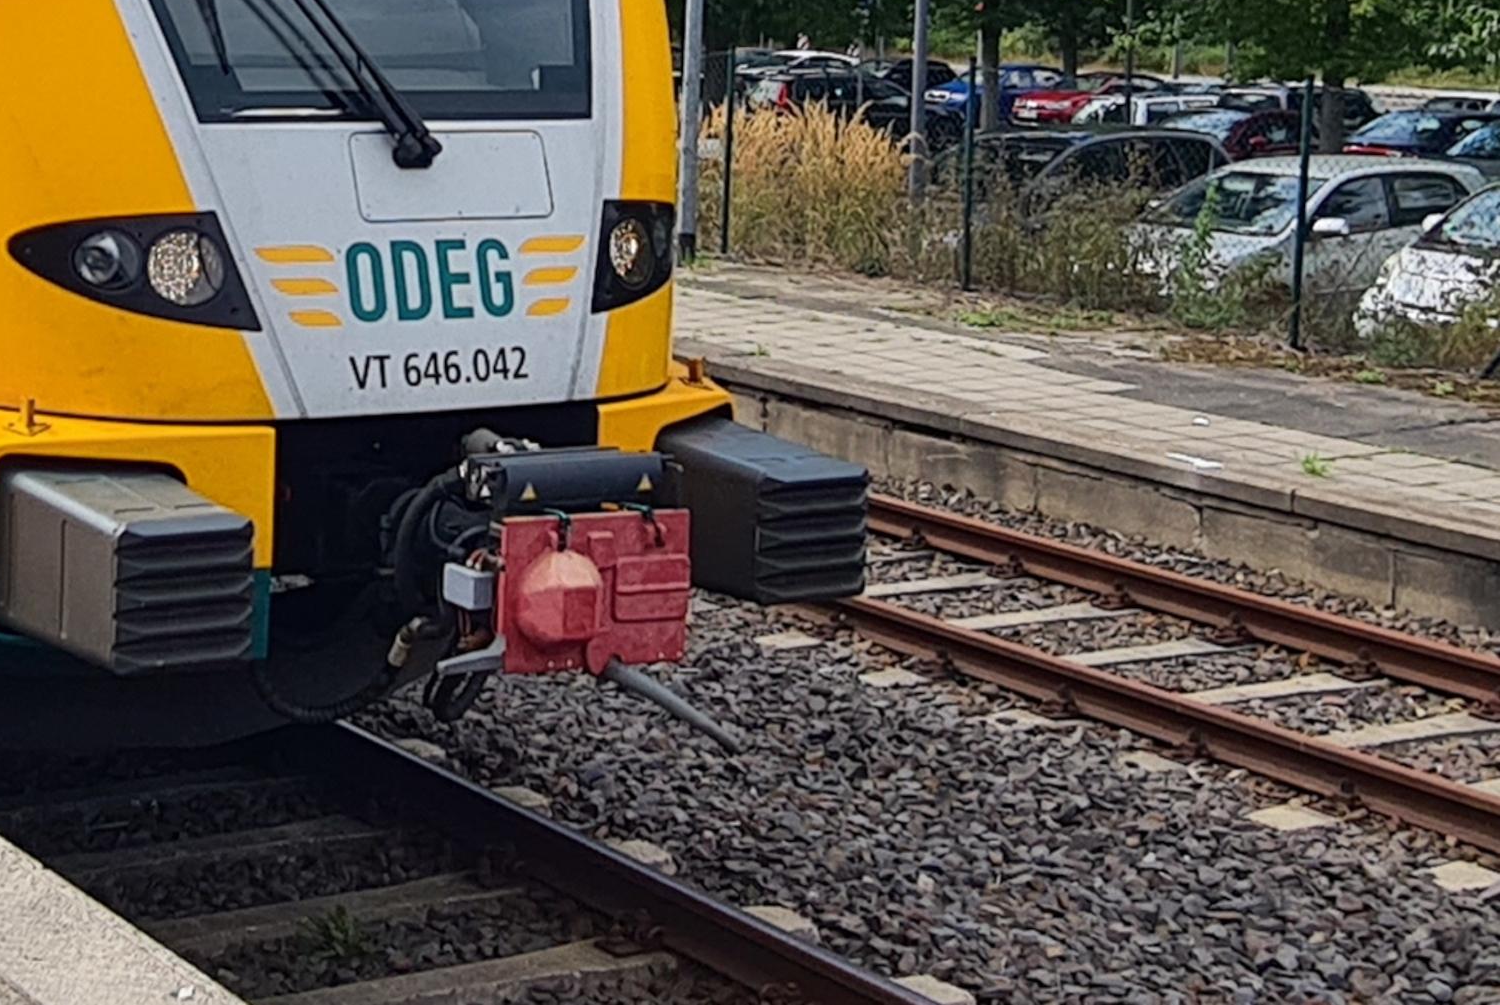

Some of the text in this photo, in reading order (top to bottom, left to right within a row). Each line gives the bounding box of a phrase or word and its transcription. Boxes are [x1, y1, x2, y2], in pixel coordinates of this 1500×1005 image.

[344, 237, 516, 323] ODEG
[349, 346, 529, 390] VT 646.042
